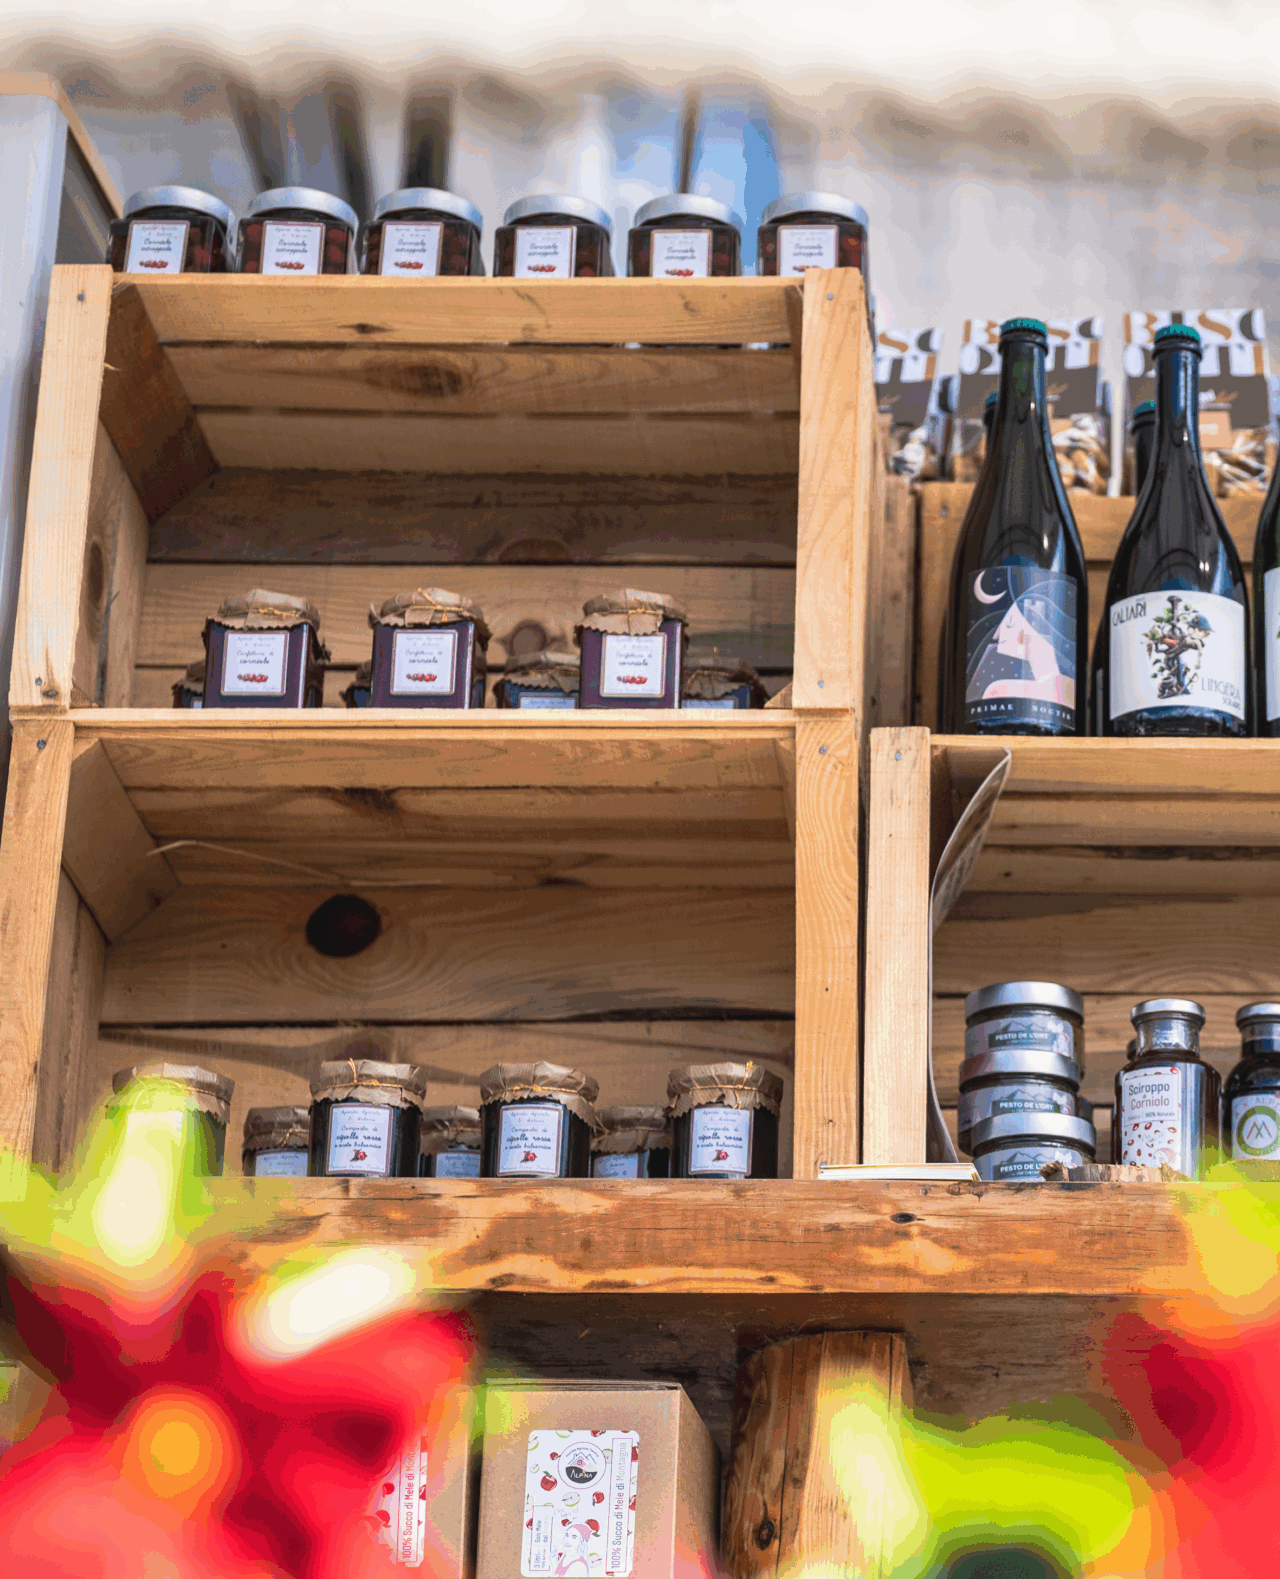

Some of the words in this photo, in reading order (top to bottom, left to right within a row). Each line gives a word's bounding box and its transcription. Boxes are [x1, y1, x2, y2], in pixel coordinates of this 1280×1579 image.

[971, 703, 1014, 715] PRIMAE
[1031, 705, 1071, 720] NOCTIS
[1129, 1083, 1170, 1096] Sciroppo
[1131, 1096, 1170, 1110] Corniolo
[1000, 1164, 1023, 1172] PESTO
[616, 1442, 628, 1481] Montagna
[404, 1482, 414, 1500] Mele
[616, 1482, 625, 1491] di
[404, 1502, 413, 1510] di
[615, 1492, 624, 1510] Mele
[402, 1511, 412, 1536] Succo
[614, 1510, 623, 1520] di
[612, 1523, 622, 1546] Succo
[402, 1537, 412, 1559] 100%
[611, 1549, 621, 1569] 100%
